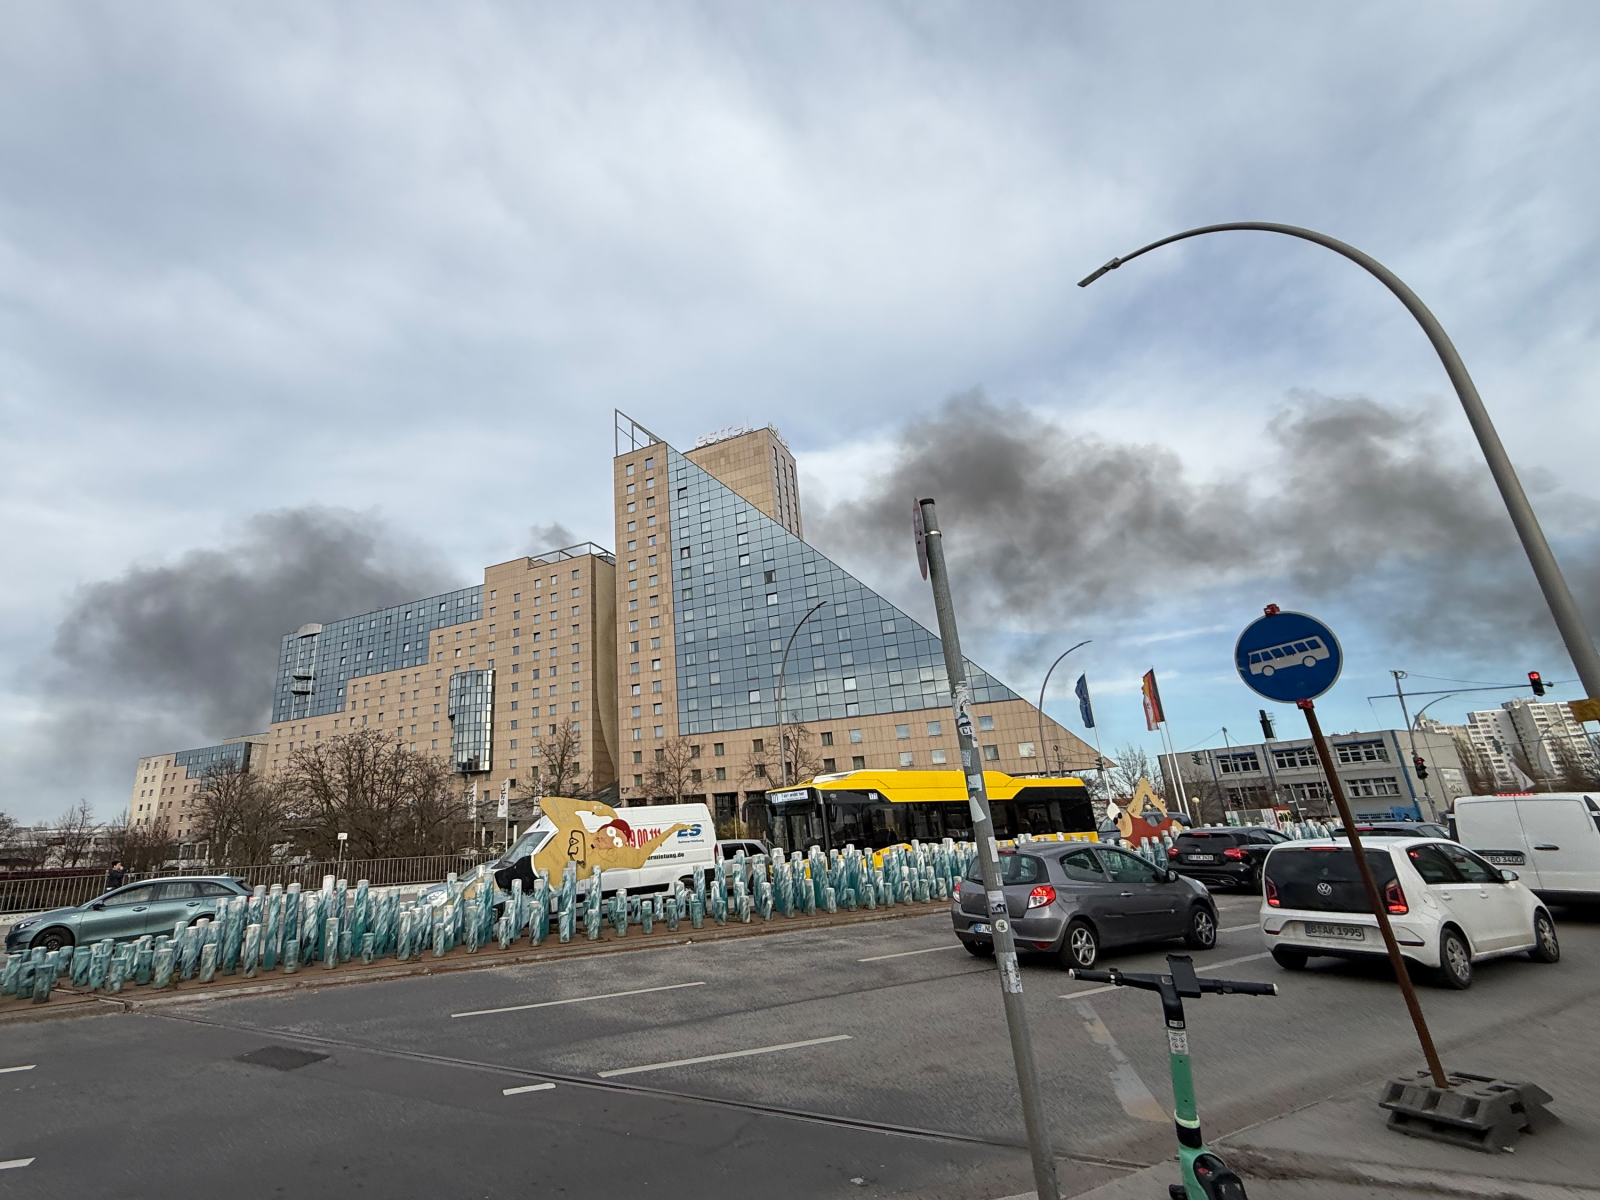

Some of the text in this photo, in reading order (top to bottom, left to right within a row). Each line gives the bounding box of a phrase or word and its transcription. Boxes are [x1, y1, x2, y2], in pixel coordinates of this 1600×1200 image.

[1311, 925, 1362, 937] B AK 1995
